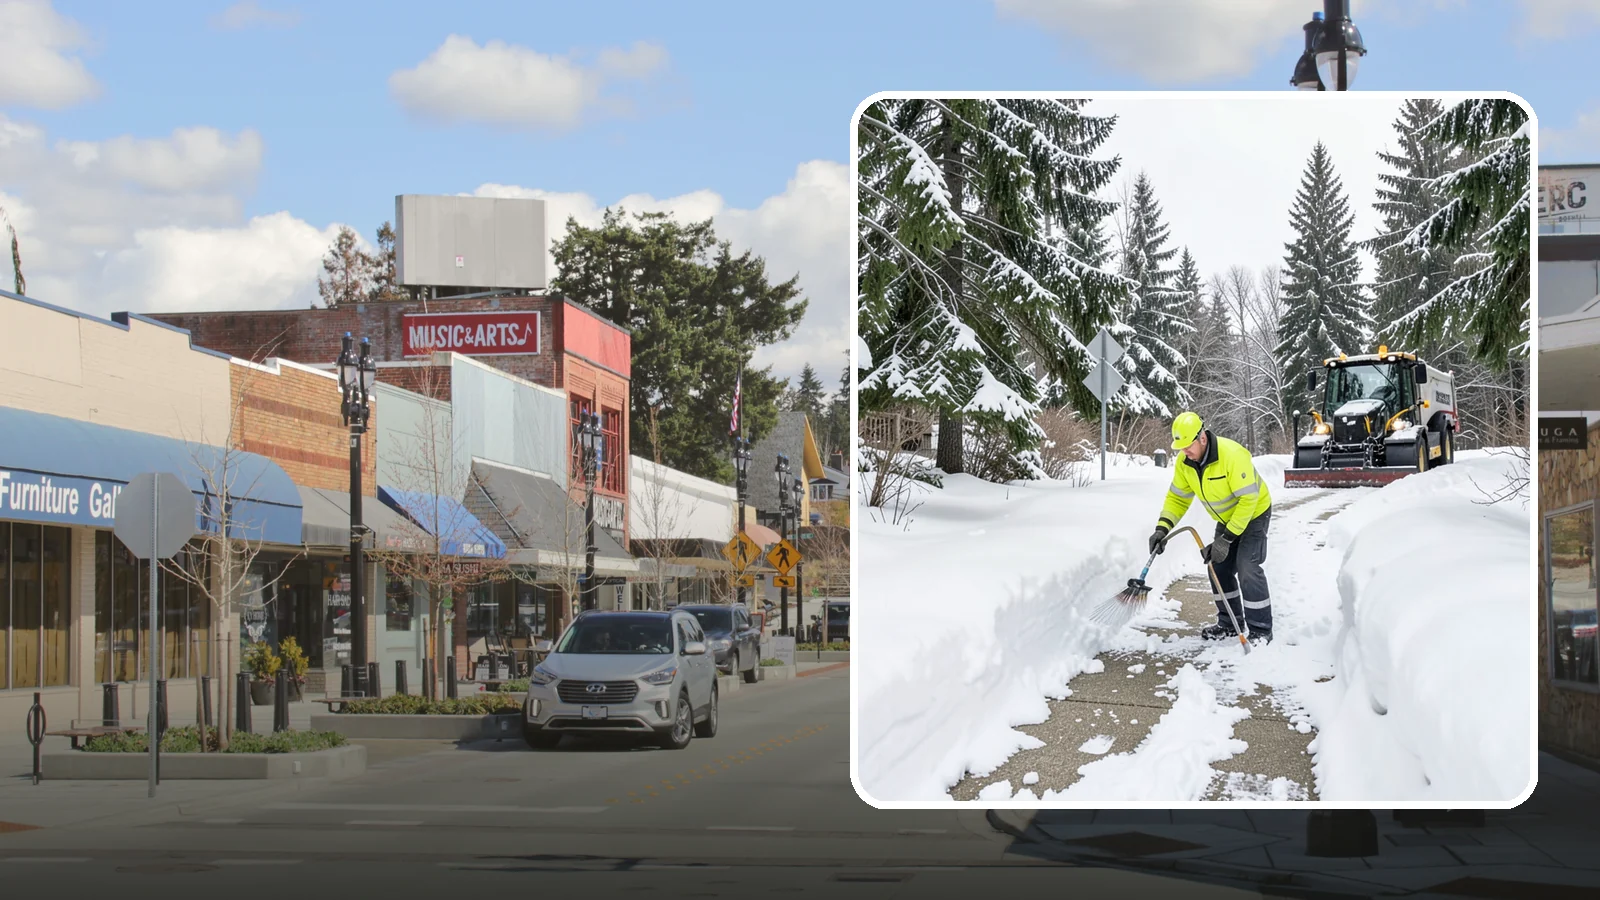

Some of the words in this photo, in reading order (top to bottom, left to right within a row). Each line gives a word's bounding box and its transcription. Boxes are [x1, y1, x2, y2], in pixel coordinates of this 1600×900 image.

[1540, 427, 1578, 437] UGA
[0, 471, 79, 515] Furniture
[89, 482, 121, 519] Gal
[453, 563, 480, 574] SUSHI
